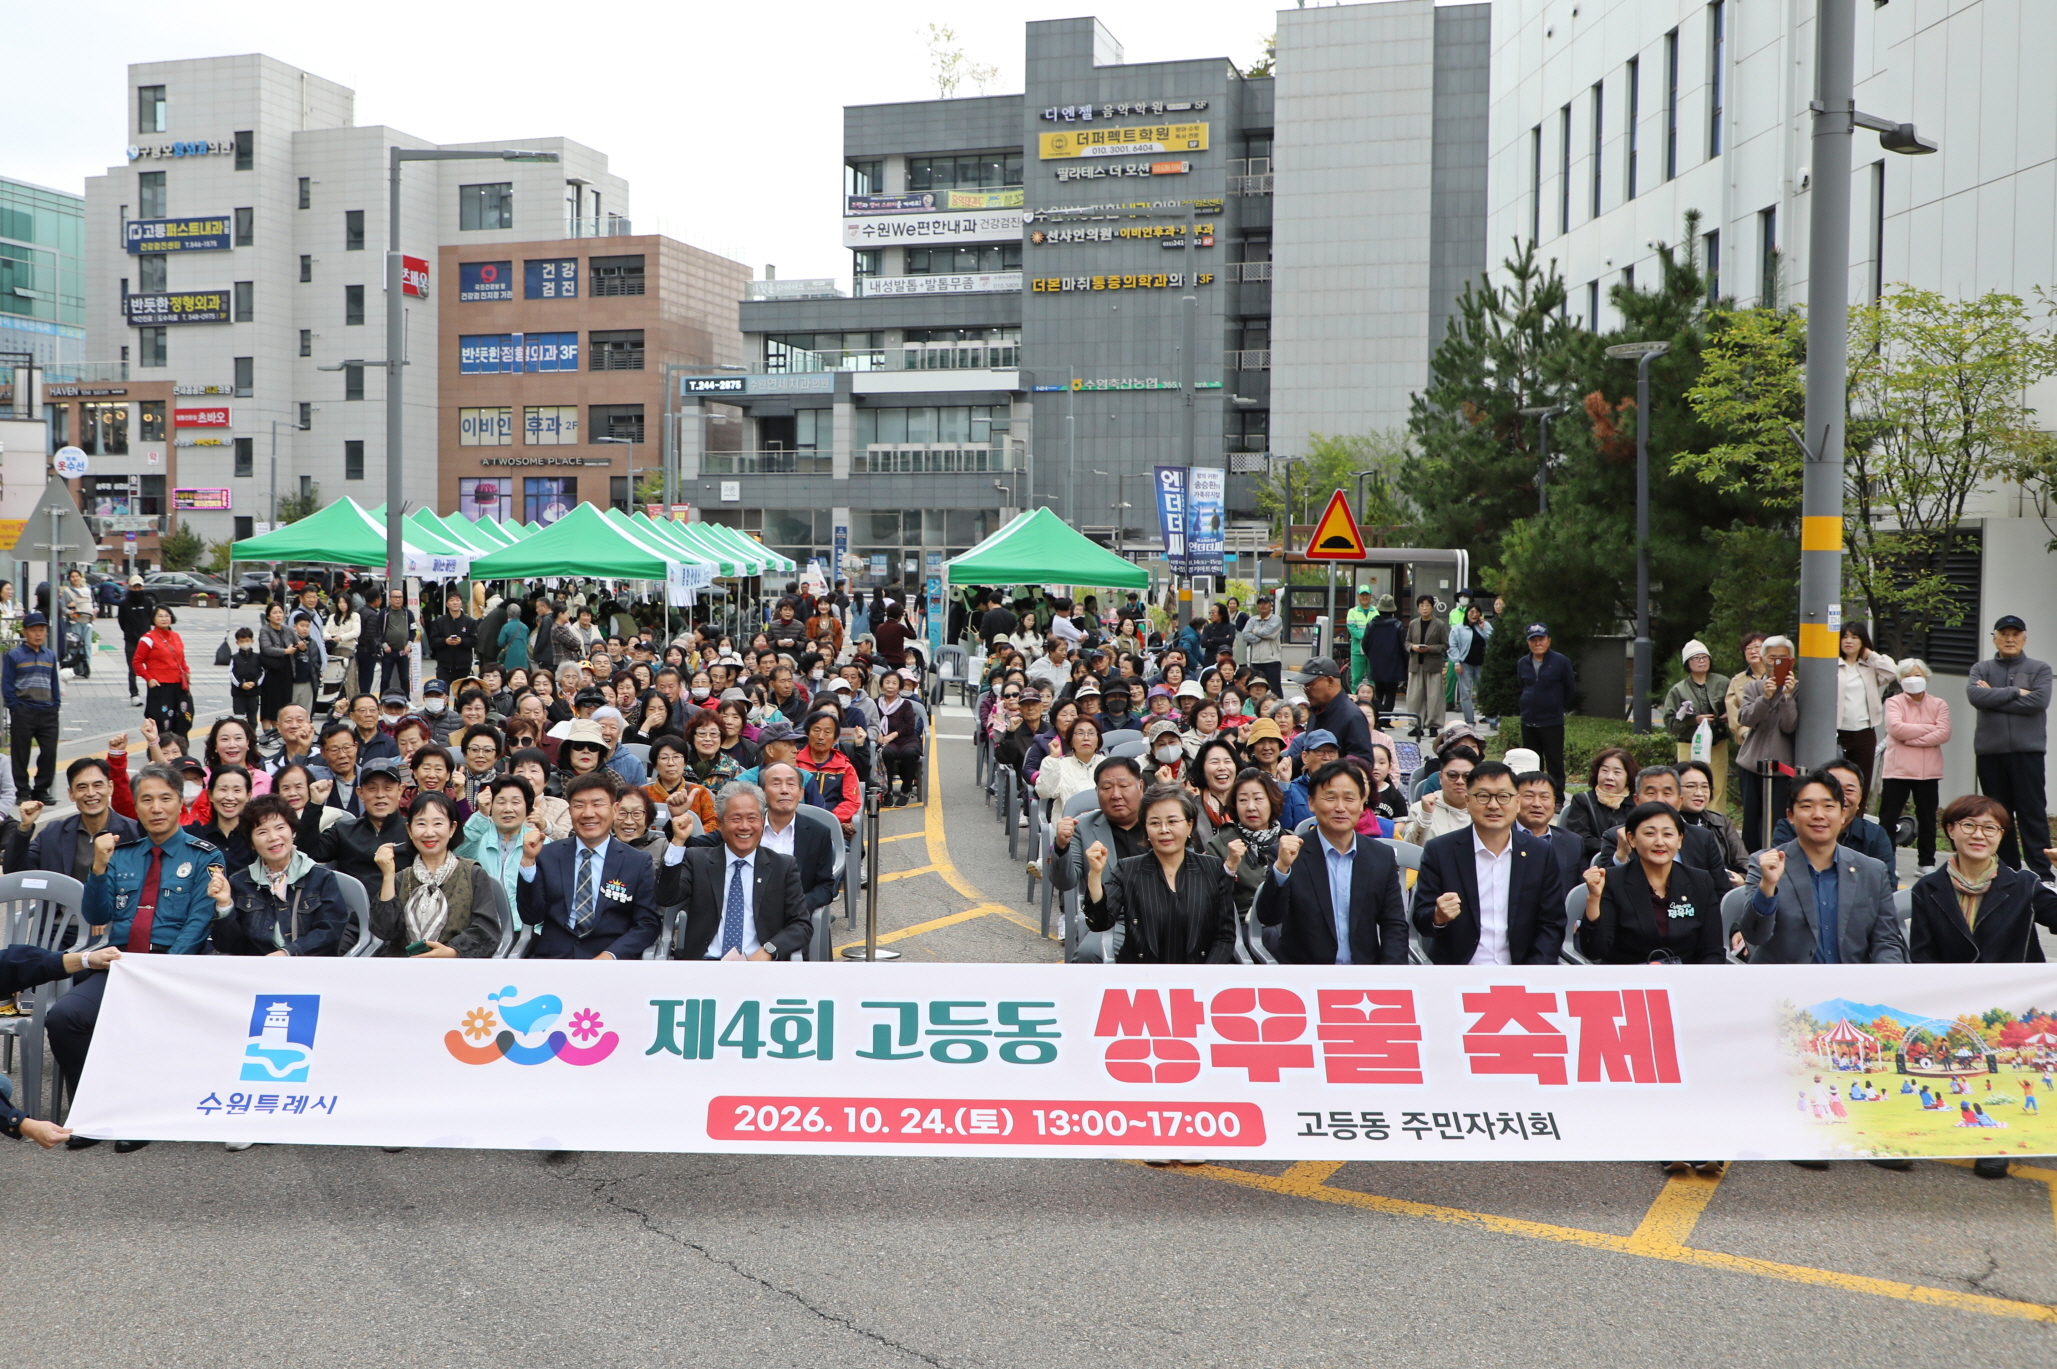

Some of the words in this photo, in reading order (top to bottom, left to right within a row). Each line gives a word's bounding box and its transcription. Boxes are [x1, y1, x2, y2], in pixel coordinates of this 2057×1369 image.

[1045, 105, 1093, 122] 디엔젤
[1102, 100, 1163, 119] 음악학원
[1077, 127, 1170, 146] 더퍼펙트학원
[1133, 144, 1154, 152] 6404
[1057, 165, 1106, 182] 필라테스
[1109, 164, 1122, 177] 더
[1125, 163, 1150, 177] 모션
[143, 220, 223, 239] 고등퍼스트내과
[862, 219, 977, 239] 수원We편한내과
[1046, 227, 1112, 243] 선샤인의원
[1198, 275, 1213, 285] 3F
[131, 294, 221, 314] 반듯한정형외과
[462, 345, 558, 363] 반듯한정형외과
[560, 344, 578, 360] 3F
[49, 386, 79, 397] HAVEN
[689, 380, 742, 391] T.244-2875
[1084, 377, 1157, 391] 수원축산농협
[565, 420, 578, 430] 2F
[58, 461, 85, 472] 옷수선
[482, 458, 489, 466] A
[493, 457, 544, 466] TWOSOME
[548, 456, 582, 466] PLACE
[1160, 470, 1185, 556] 언더더씨
[1188, 541, 1223, 553] 언더더씨
[644, 998, 835, 1061] 제4회
[855, 1000, 1062, 1065] 고등동
[1093, 987, 1424, 1085] 쌍우물
[1461, 985, 1682, 1086] 축제
[196, 1091, 338, 1116] 수원특례시
[733, 1104, 833, 1133] 2026.
[843, 1106, 890, 1133] 10.
[900, 1106, 1014, 1136] 24.(토)
[1032, 1109, 1241, 1138] 13:00~17:00
[1296, 1112, 1391, 1140] 고등동
[1401, 1111, 1562, 1141] 주민자치회
